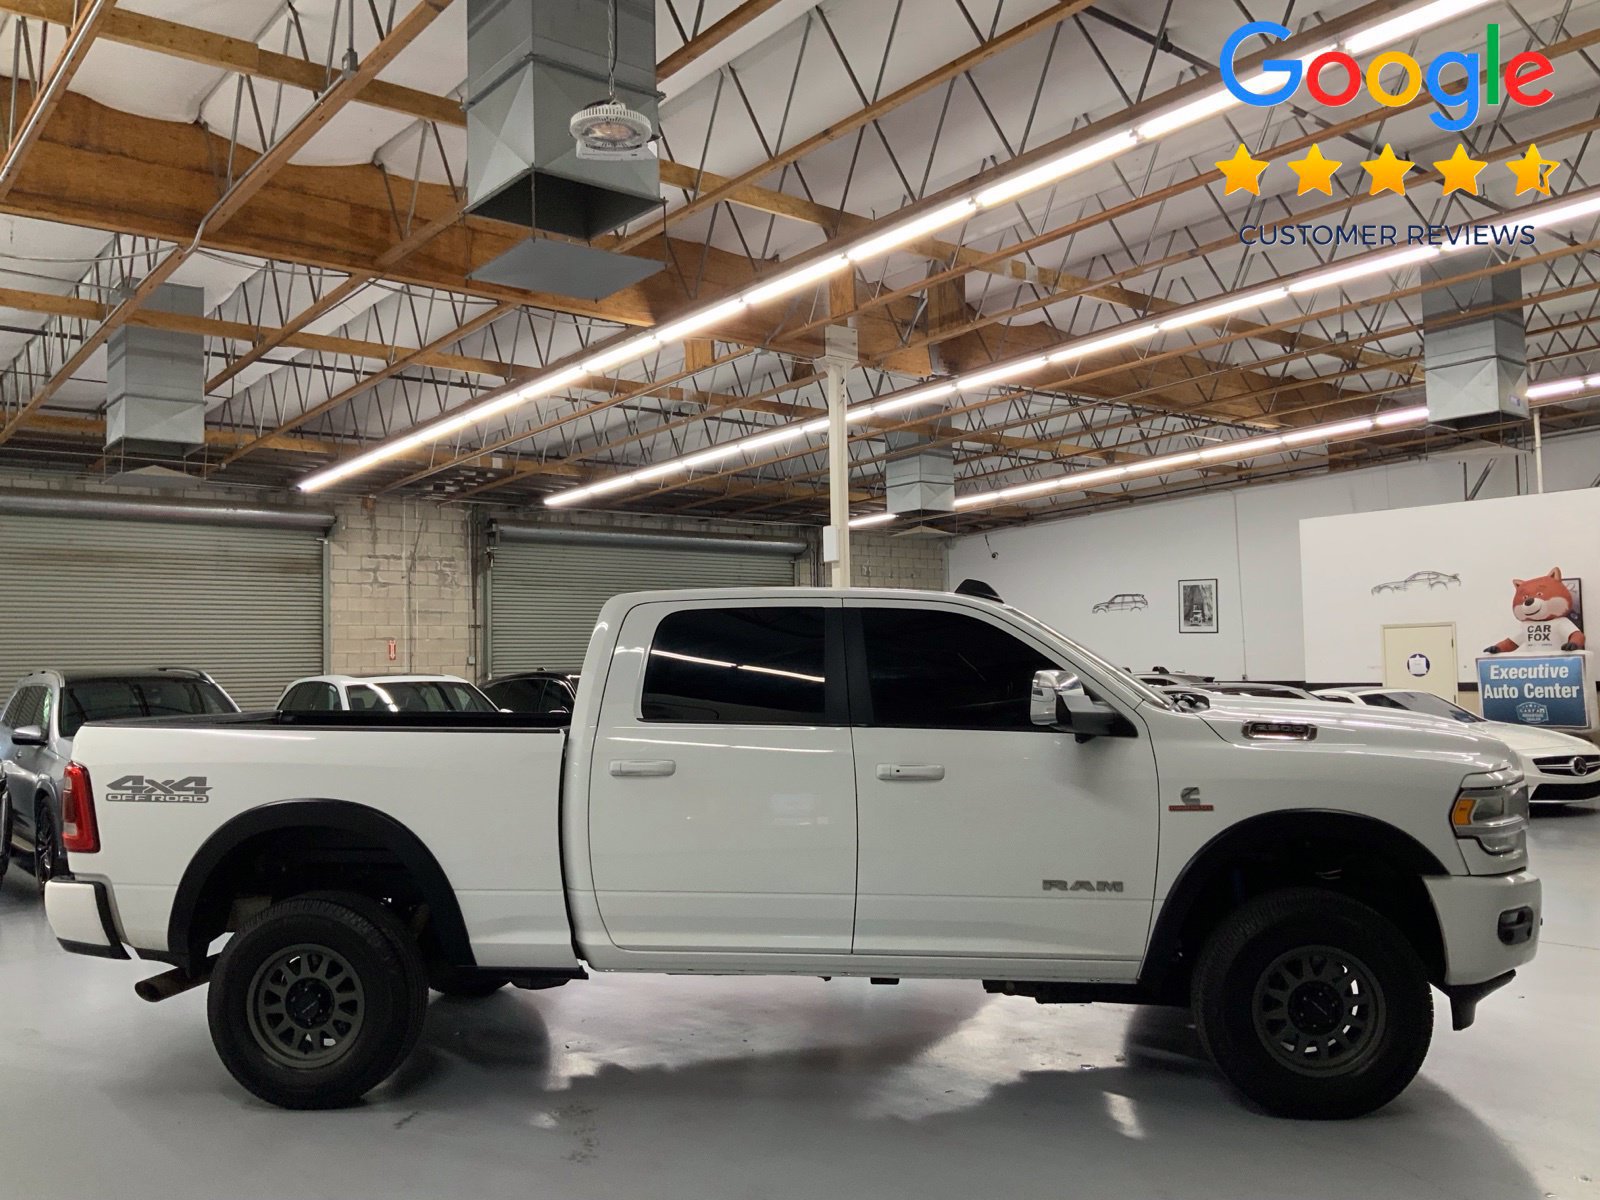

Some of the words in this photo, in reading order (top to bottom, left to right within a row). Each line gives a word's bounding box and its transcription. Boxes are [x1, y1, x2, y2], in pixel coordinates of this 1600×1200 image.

[1527, 625, 1552, 633] CAR
[1527, 633, 1551, 641] FOX
[1490, 663, 1569, 680] Executive
[1484, 683, 1519, 699] Auto
[1523, 683, 1580, 698] Center
[151, 795, 207, 803] ROAD
[1042, 880, 1124, 892] RAM
